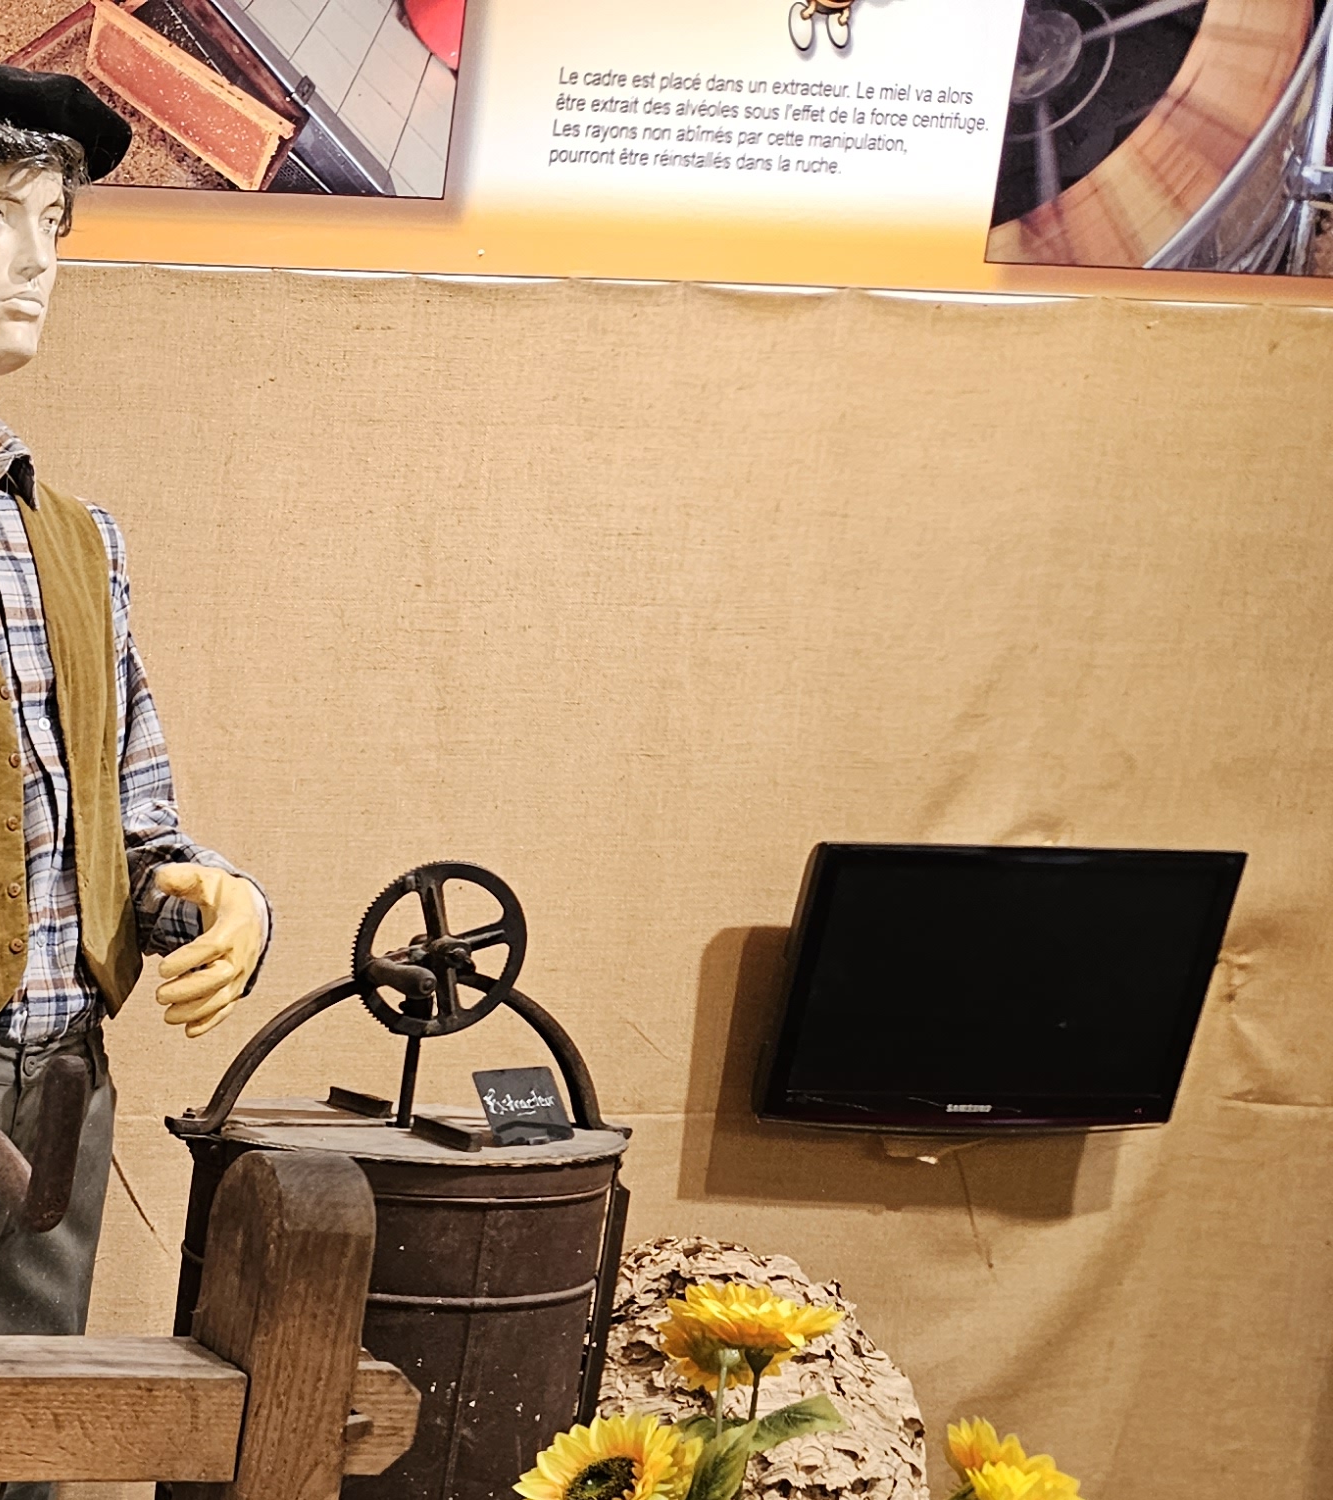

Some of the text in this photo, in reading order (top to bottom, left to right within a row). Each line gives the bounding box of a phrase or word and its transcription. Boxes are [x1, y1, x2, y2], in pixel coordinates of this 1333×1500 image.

[558, 66, 974, 105] Le cadre est placé dans un extracteur. Le miel va alors
[556, 92, 989, 134] être extrait des alvéoles sous l'effet de la force centrifuge.
[552, 118, 907, 154] Les rayons non abîmés par cette manipulation,
[548, 148, 841, 174] pourront être réinstallés dans la ruche.
